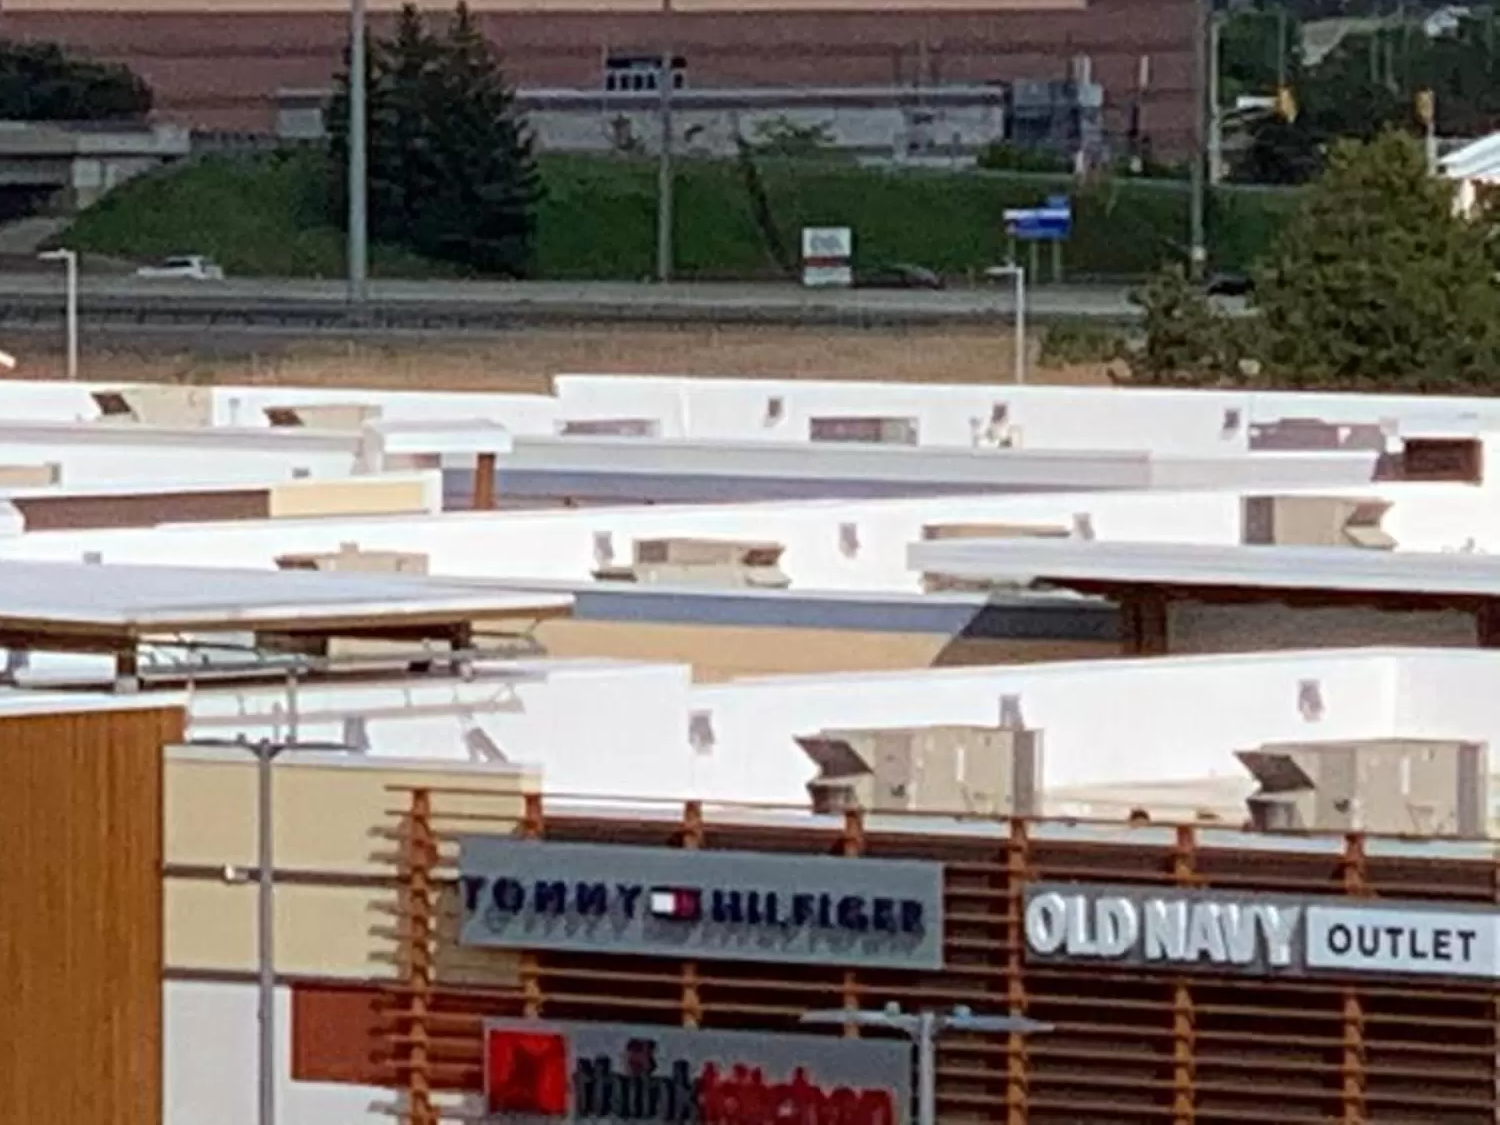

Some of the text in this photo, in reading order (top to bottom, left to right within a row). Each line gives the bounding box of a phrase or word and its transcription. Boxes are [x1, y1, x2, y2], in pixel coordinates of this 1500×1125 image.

[462, 874, 924, 934] TOMMY HILFIGER
[1025, 891, 1477, 966] OLD NAVY OUTLET
